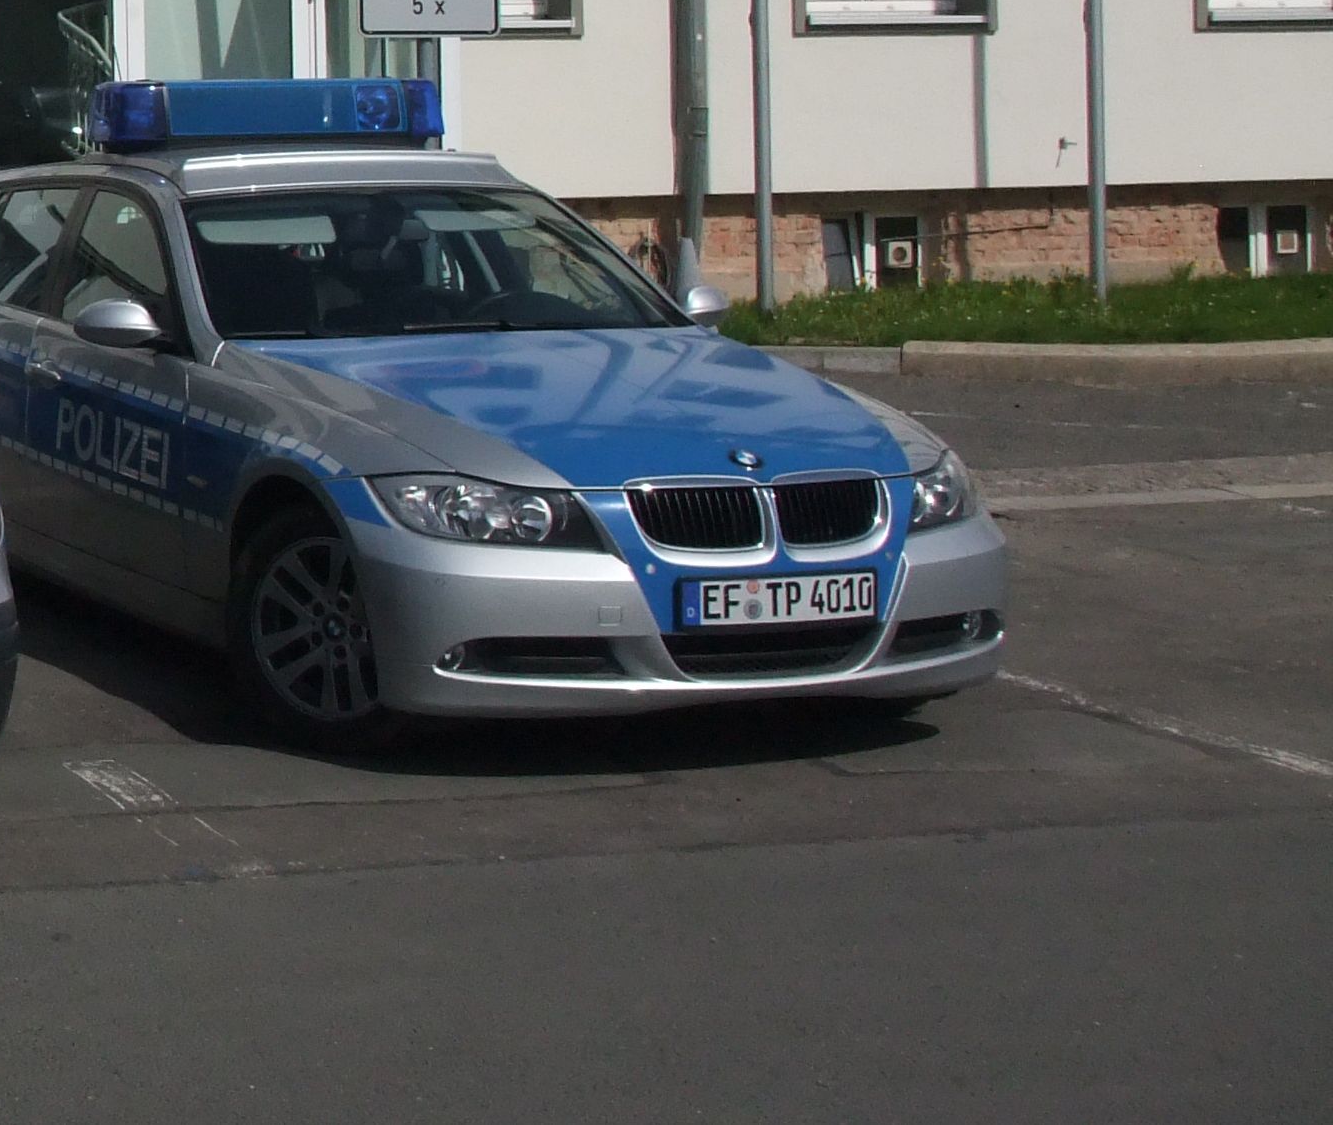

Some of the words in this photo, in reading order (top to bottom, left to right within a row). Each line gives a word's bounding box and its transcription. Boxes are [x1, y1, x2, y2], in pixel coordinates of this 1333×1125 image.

[435, 0, 445, 15] x
[55, 396, 170, 490] POLIZEI
[686, 607, 695, 617] D
[702, 583, 741, 620] EF
[765, 580, 801, 617] TP
[810, 575, 872, 615] 4010
